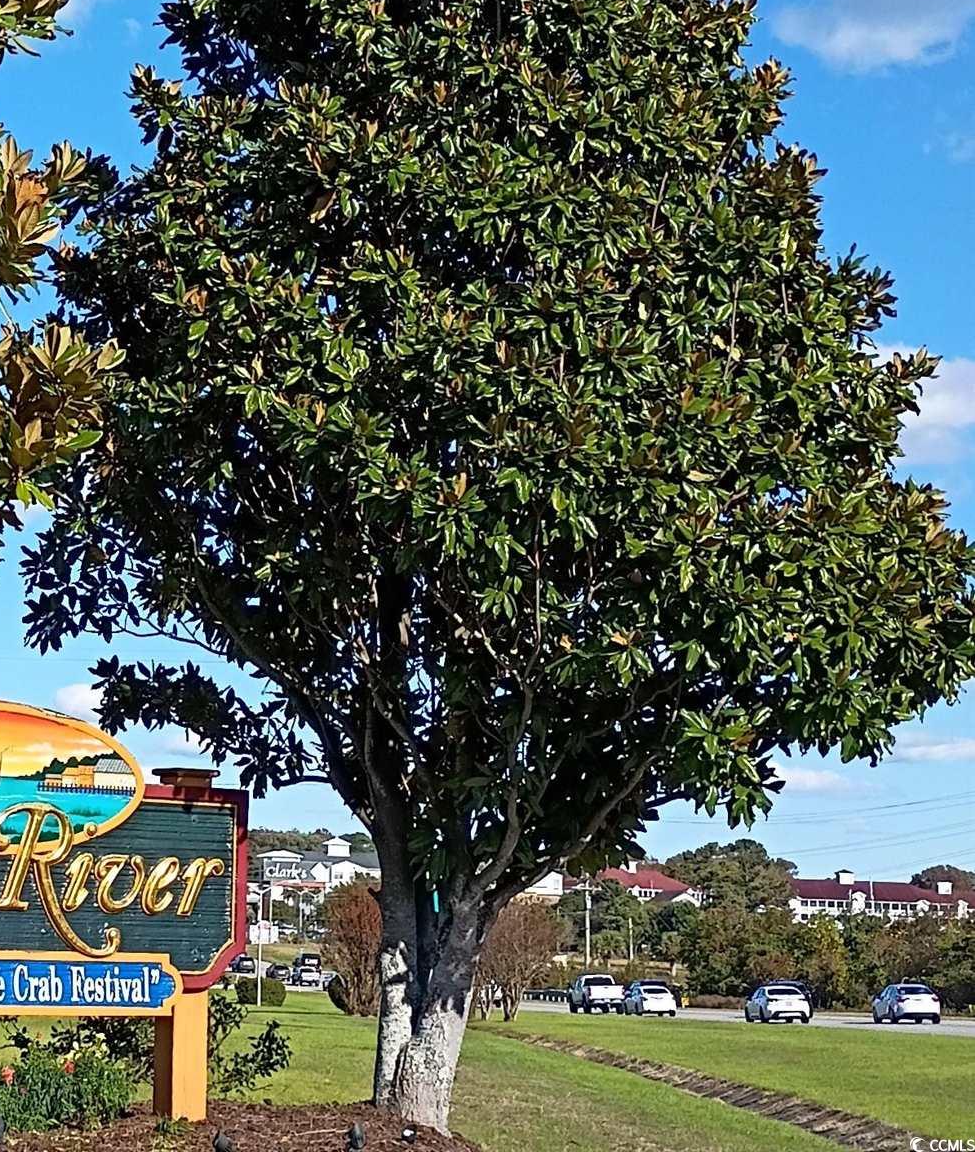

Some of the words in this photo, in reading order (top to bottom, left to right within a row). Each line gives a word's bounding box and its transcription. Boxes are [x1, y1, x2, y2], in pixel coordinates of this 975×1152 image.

[265, 862, 308, 880] Clark's
[13, 964, 63, 1002] Crab
[70, 966, 161, 1003] Festival"
